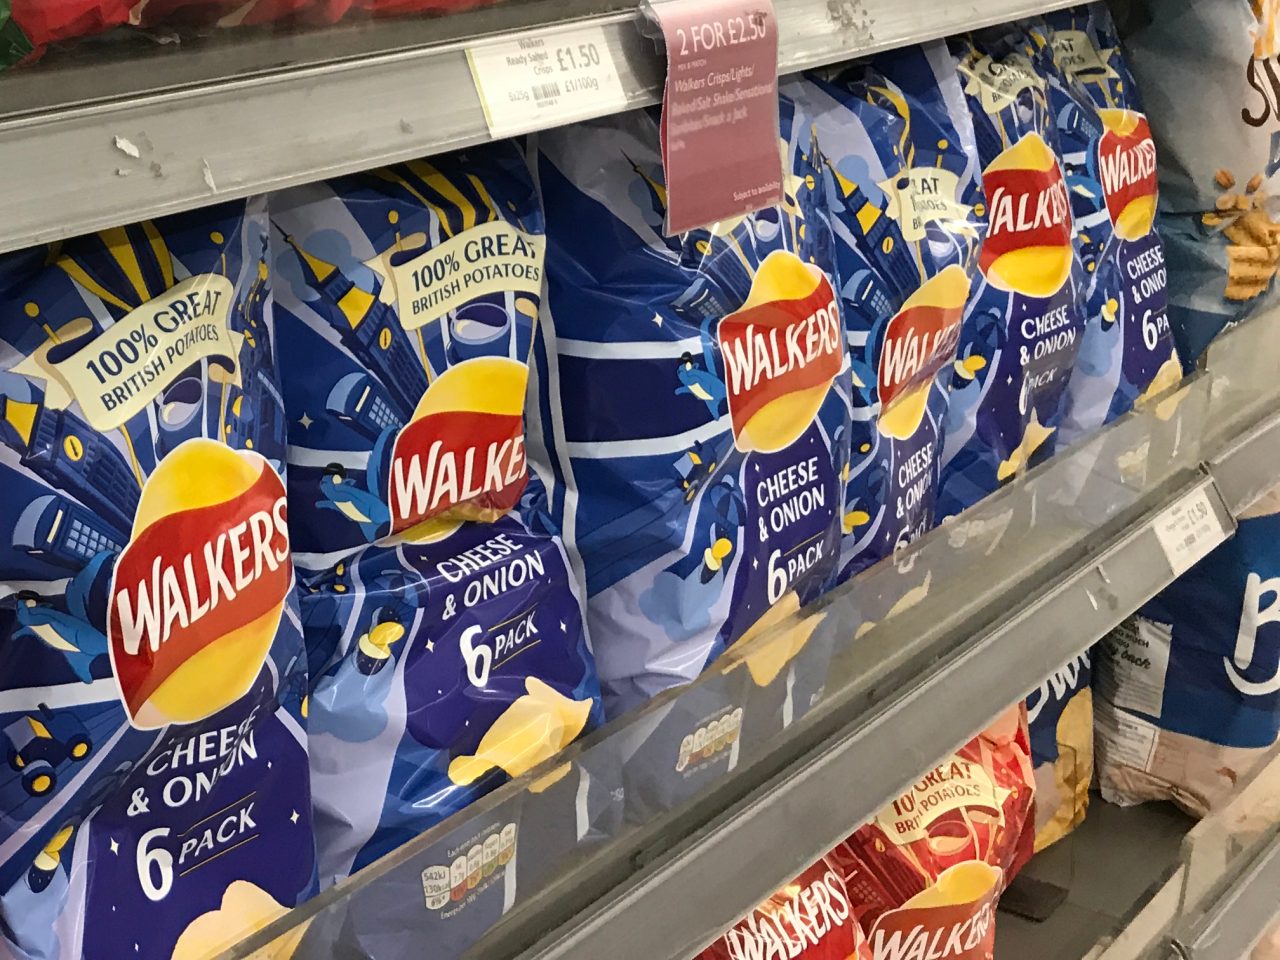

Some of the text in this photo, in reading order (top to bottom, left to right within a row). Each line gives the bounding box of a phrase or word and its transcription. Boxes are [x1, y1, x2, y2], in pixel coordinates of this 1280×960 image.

[556, 43, 600, 72] £1.50
[677, 14, 767, 56] 2 FOR £2.50
[411, 234, 537, 292] 100% GREAT
[1127, 244, 1164, 280] CHEESE
[411, 263, 540, 315] BRITISH POTATOES
[1132, 285, 1142, 304] &
[86, 289, 222, 384] 100% GREAT
[1020, 326, 1078, 366] & ONION
[1021, 304, 1070, 339] CHEESE
[1142, 309, 1158, 351] 6
[100, 324, 219, 411] BRITISH POTATOES
[722, 300, 840, 396] WALKERS
[394, 435, 527, 520] WALKE
[756, 456, 819, 507] CHEESE
[898, 442, 933, 488] CHEESE
[758, 483, 825, 542] & ONION
[896, 496, 904, 519] &
[116, 496, 289, 655] WALKERS
[436, 533, 524, 583] CHEESE
[767, 539, 825, 605] 6 PACK
[441, 549, 545, 621] & ONION
[459, 610, 539, 688] 6 PACK
[126, 787, 150, 817] &
[920, 784, 981, 812] POTATOES
[136, 802, 257, 901] 6 PACK
[724, 871, 849, 960] WALKERS
